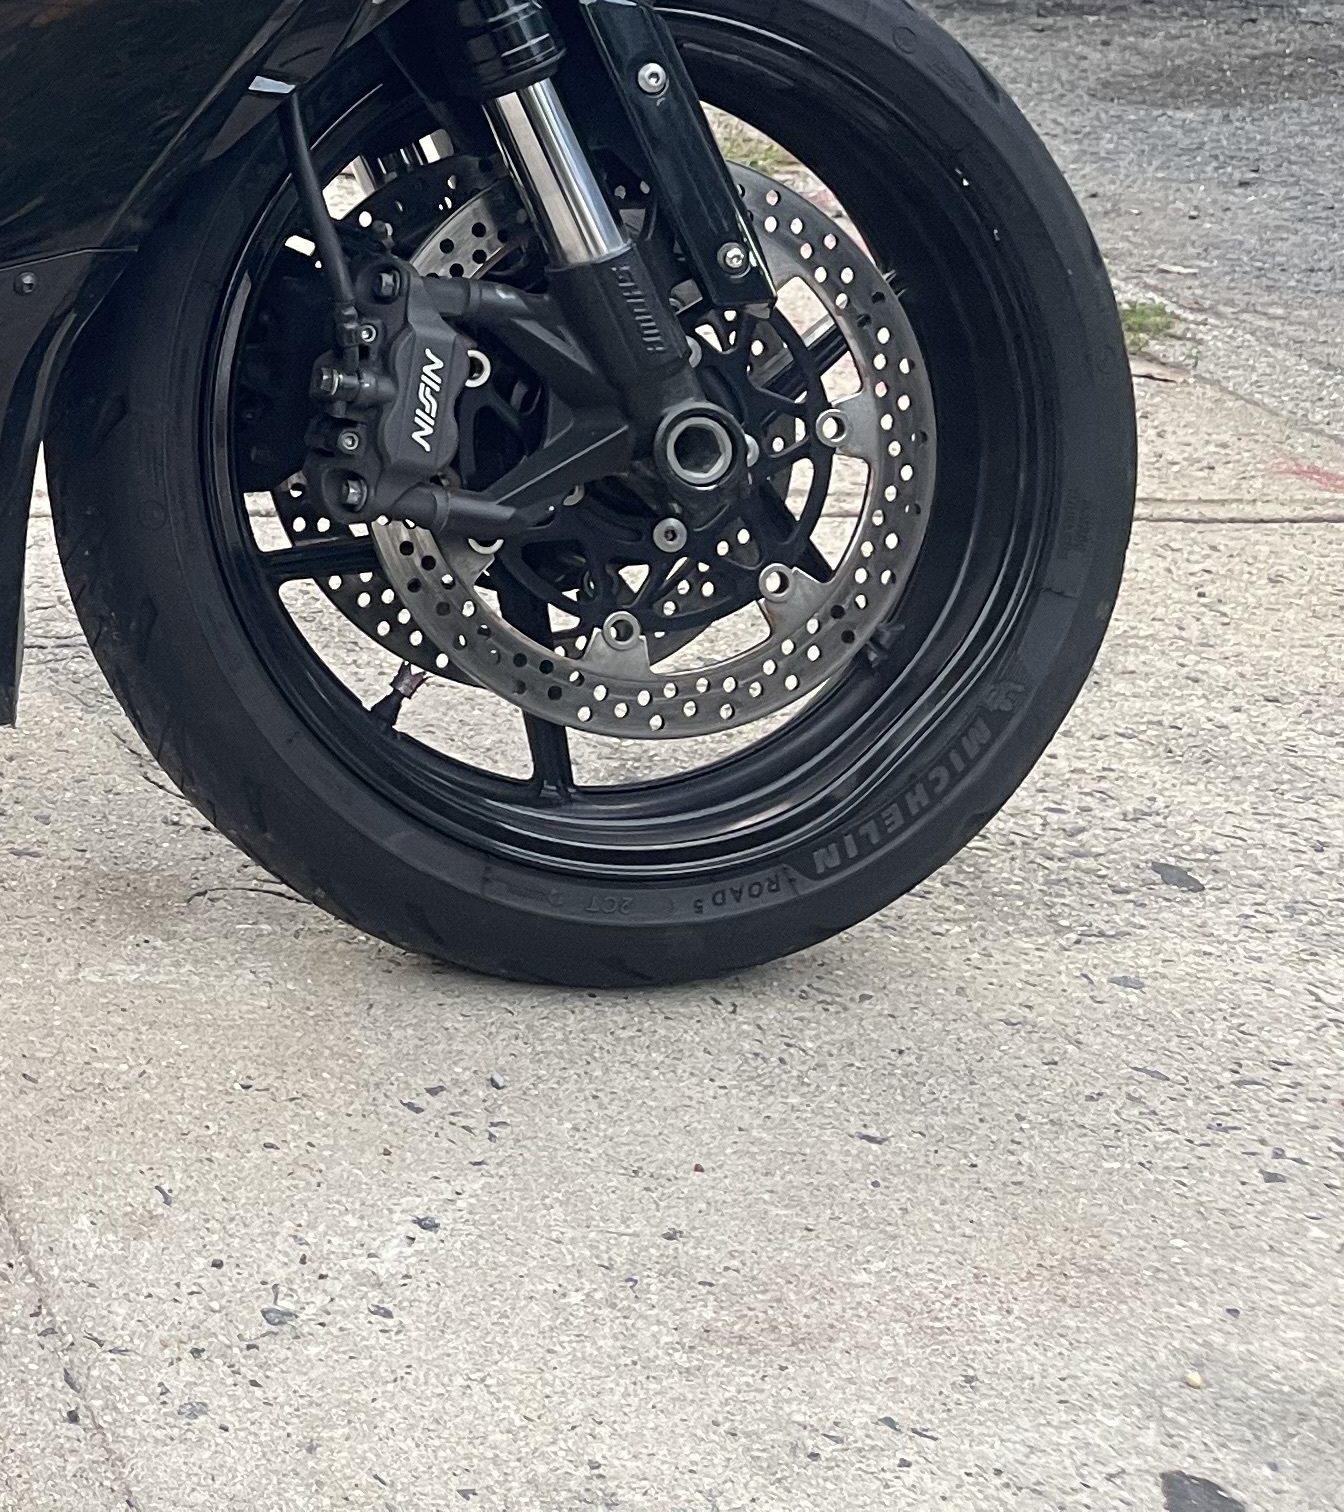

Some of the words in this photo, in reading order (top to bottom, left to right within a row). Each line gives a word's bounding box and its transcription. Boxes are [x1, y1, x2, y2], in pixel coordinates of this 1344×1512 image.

[411, 348, 444, 453] NISSIN
[812, 716, 993, 875] MICHELIN
[692, 897, 705, 915] 5
[712, 873, 781, 907] ROAD
